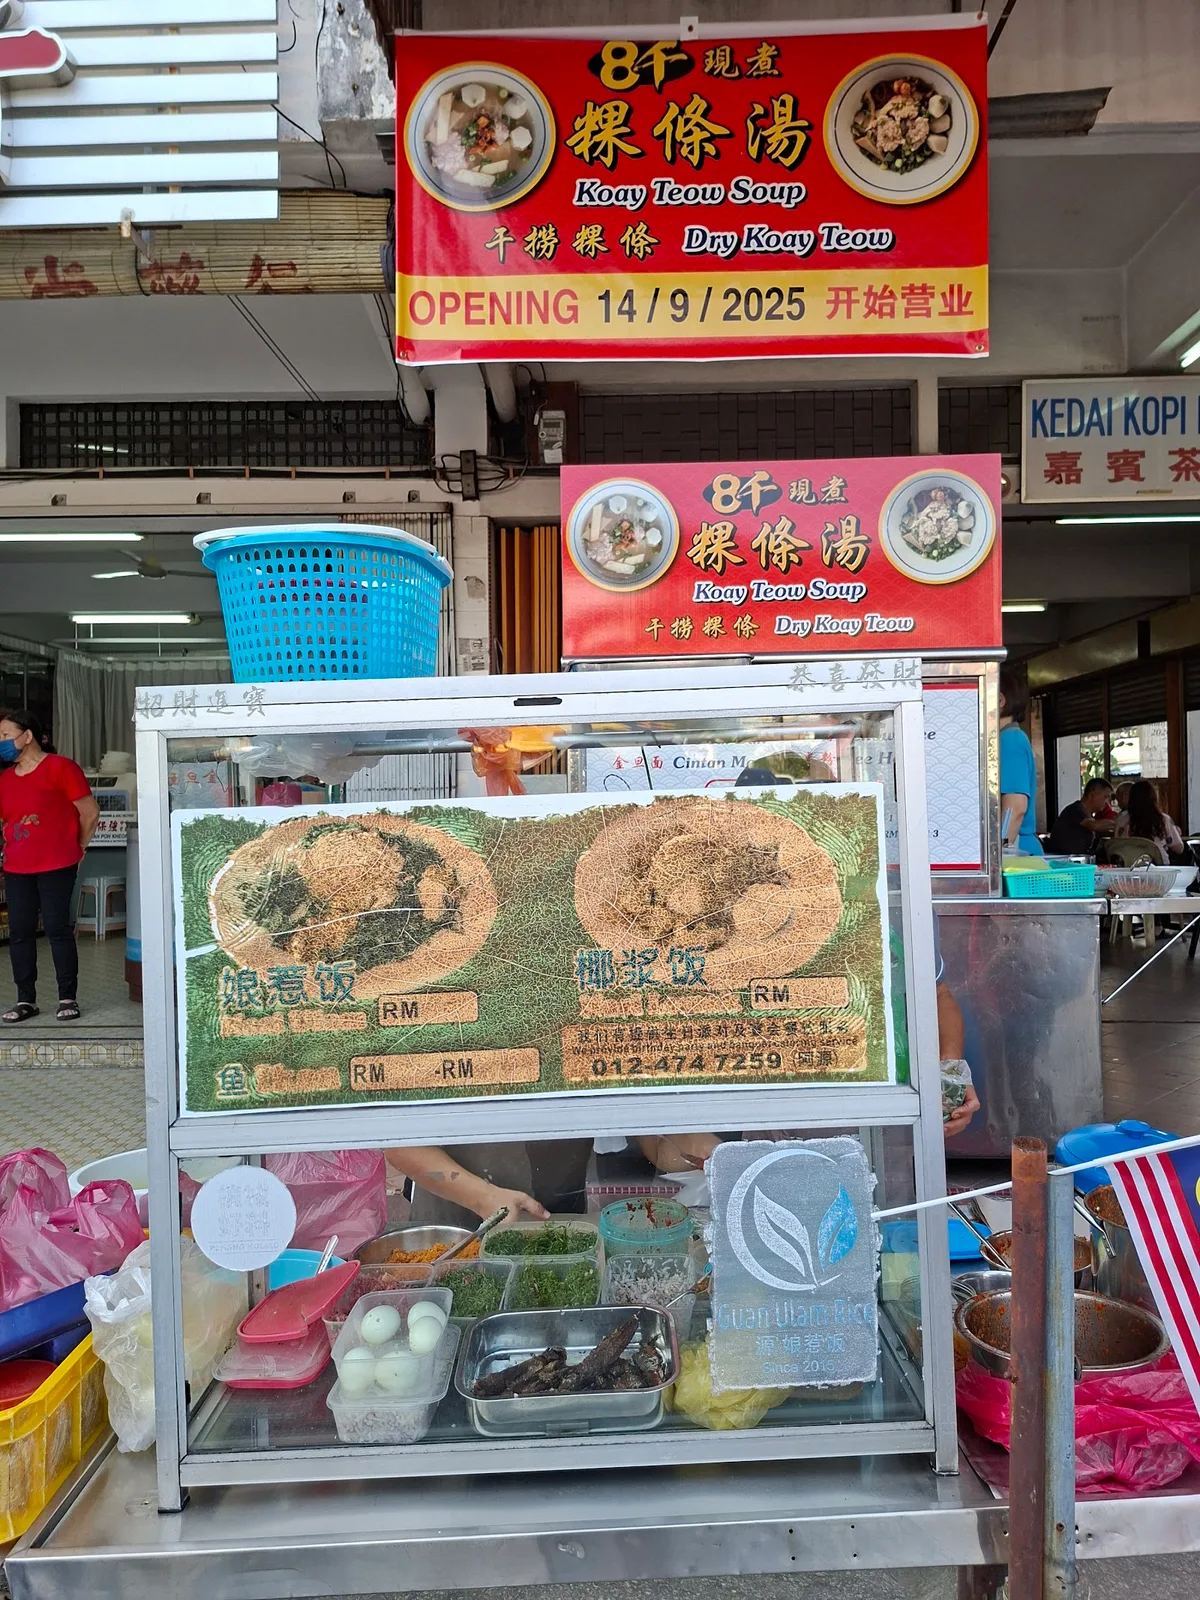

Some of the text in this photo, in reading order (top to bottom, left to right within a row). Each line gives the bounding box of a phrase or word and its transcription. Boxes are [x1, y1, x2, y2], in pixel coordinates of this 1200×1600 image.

[565, 94, 810, 168] 粿條湯
[574, 176, 807, 208] Koay Teow Soup
[683, 225, 894, 255] Dry Koay Teow
[408, 289, 579, 327] OPENING
[825, 284, 975, 321] 开始营业
[1031, 396, 1187, 439] KEDAI KOPI
[686, 515, 870, 573] 粿條湯
[693, 579, 867, 605] Koay Teow Soup
[774, 613, 915, 637] Dry Koay Teow
[786, 659, 920, 693] 恭喜發財
[136, 686, 267, 719] 招財進寶
[672, 755, 726, 770] Cintan
[576, 946, 708, 989] 椰浆饭
[221, 959, 358, 1010] 娘惹饭
[754, 984, 791, 1003] RM
[382, 1001, 420, 1020] RM
[353, 1062, 385, 1084] RM
[591, 1054, 706, 1076] 012-474
[714, 1051, 782, 1071] 7259
[717, 1297, 875, 1331] Guan Ulam Rice
